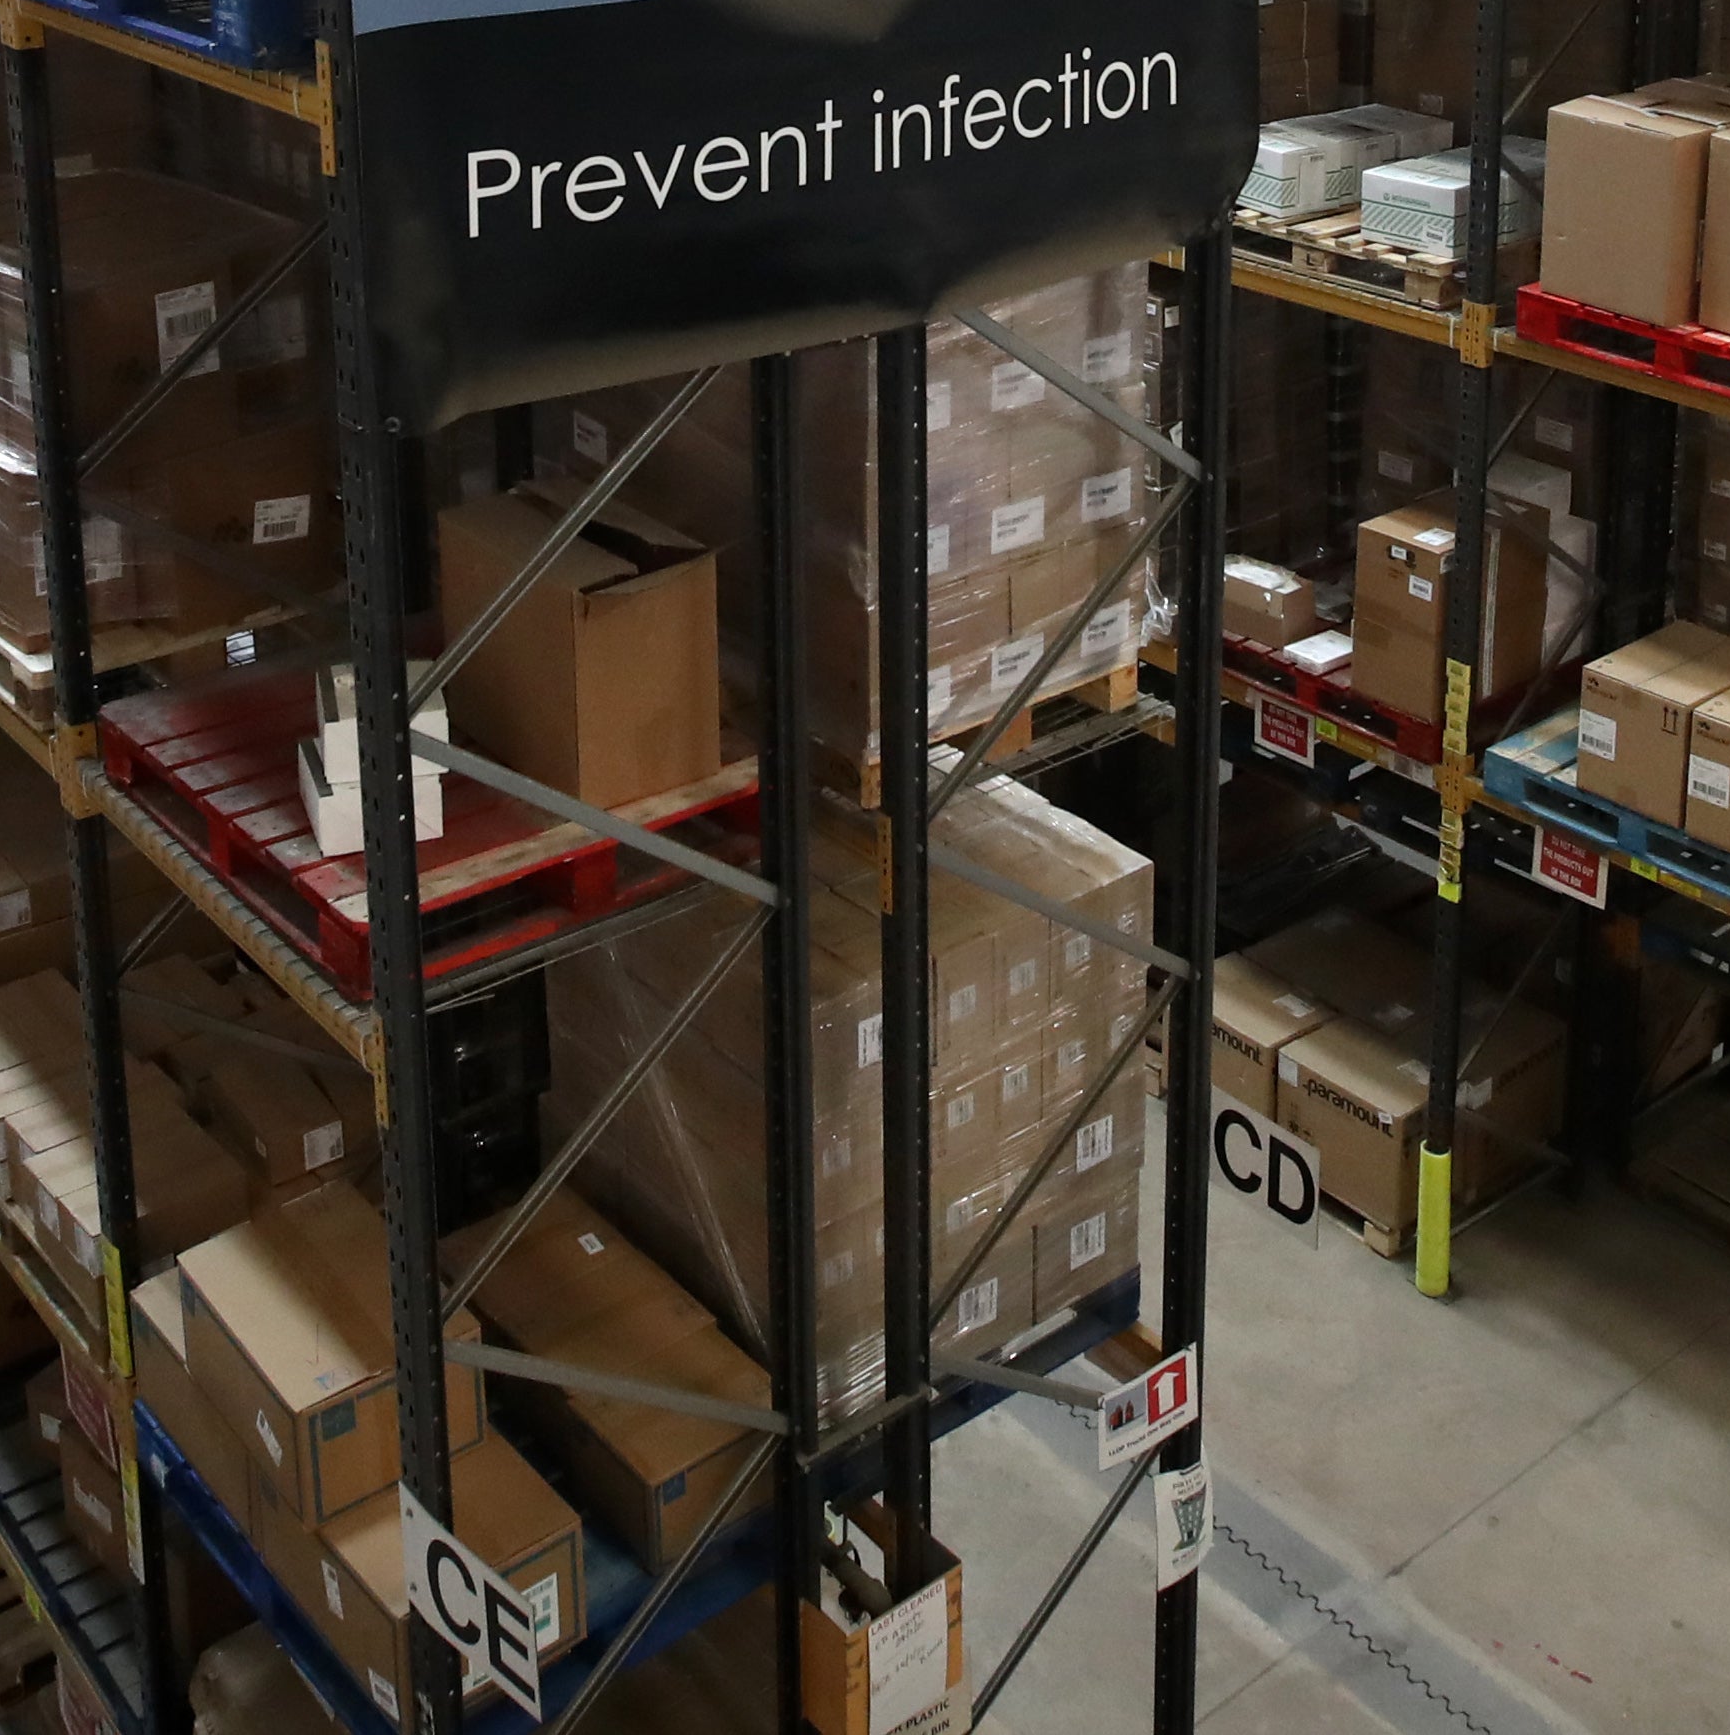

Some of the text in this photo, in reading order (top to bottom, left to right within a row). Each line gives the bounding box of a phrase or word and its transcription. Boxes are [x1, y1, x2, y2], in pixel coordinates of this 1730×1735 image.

[468, 47, 1178, 239] Prevent infection
[1303, 1077, 1394, 1139] paramount
[1214, 1108, 1316, 1225] CD
[425, 1539, 537, 1704] CE
[871, 1615, 895, 1637] LAST
[897, 1582, 943, 1618] CLEANED
[905, 1697, 951, 1729] PLASTIC
